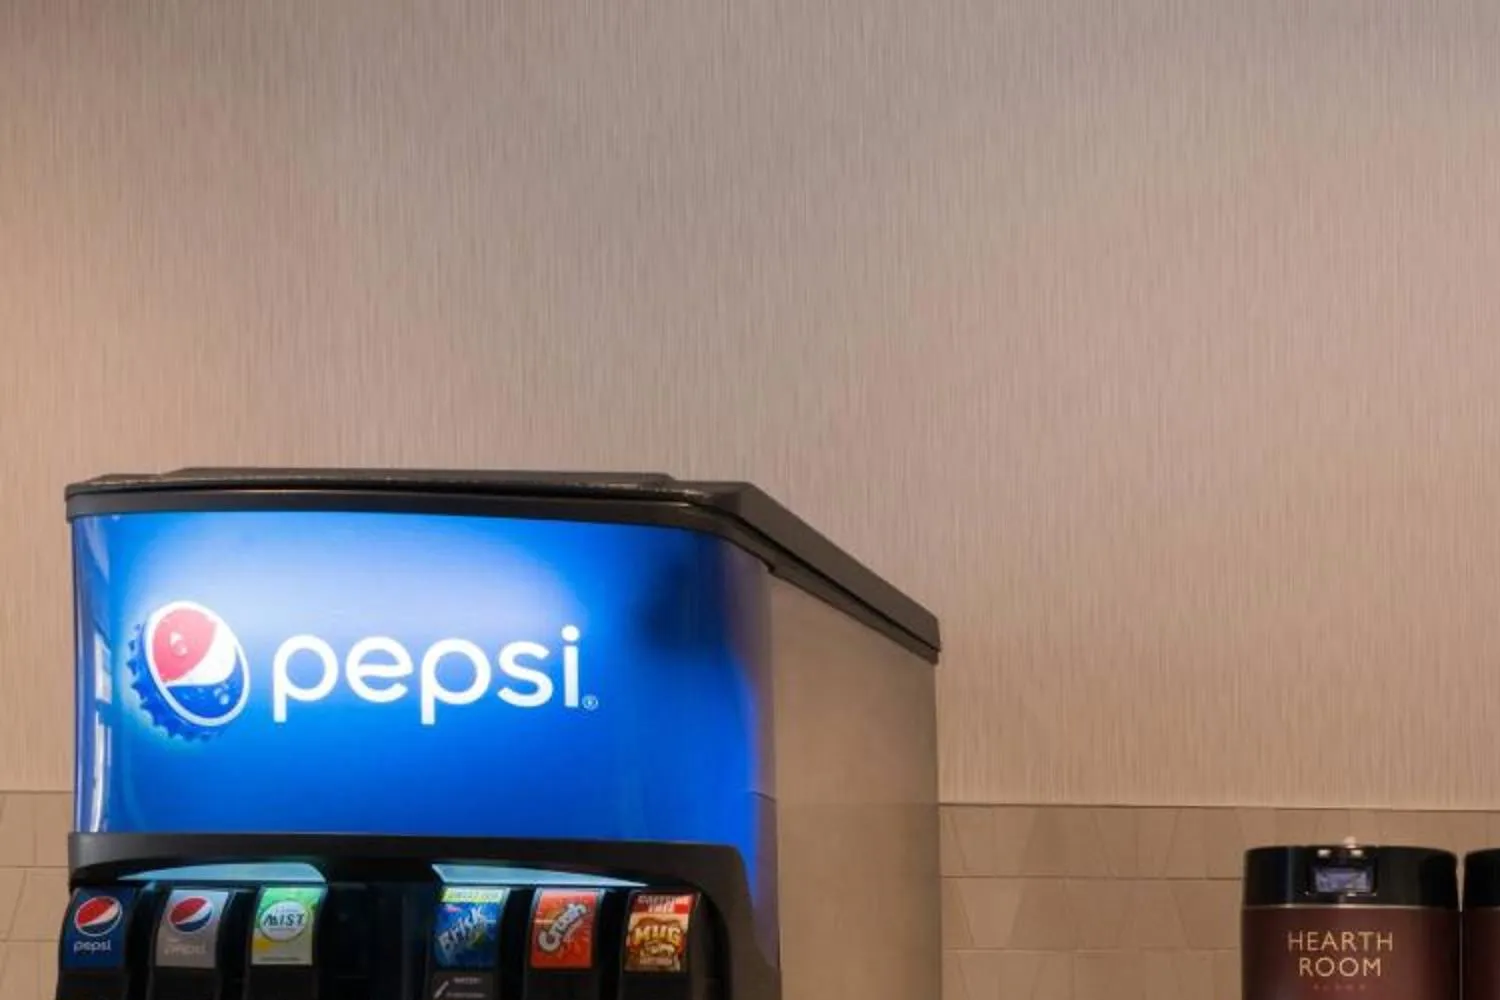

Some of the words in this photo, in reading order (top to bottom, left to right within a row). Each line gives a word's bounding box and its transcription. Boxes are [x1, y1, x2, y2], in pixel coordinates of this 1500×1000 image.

[272, 624, 581, 726] pepsi
[634, 925, 682, 945] MUG
[1287, 931, 1393, 952] HEARTH
[73, 939, 112, 956] pepsi
[1299, 957, 1381, 977] ROOM
